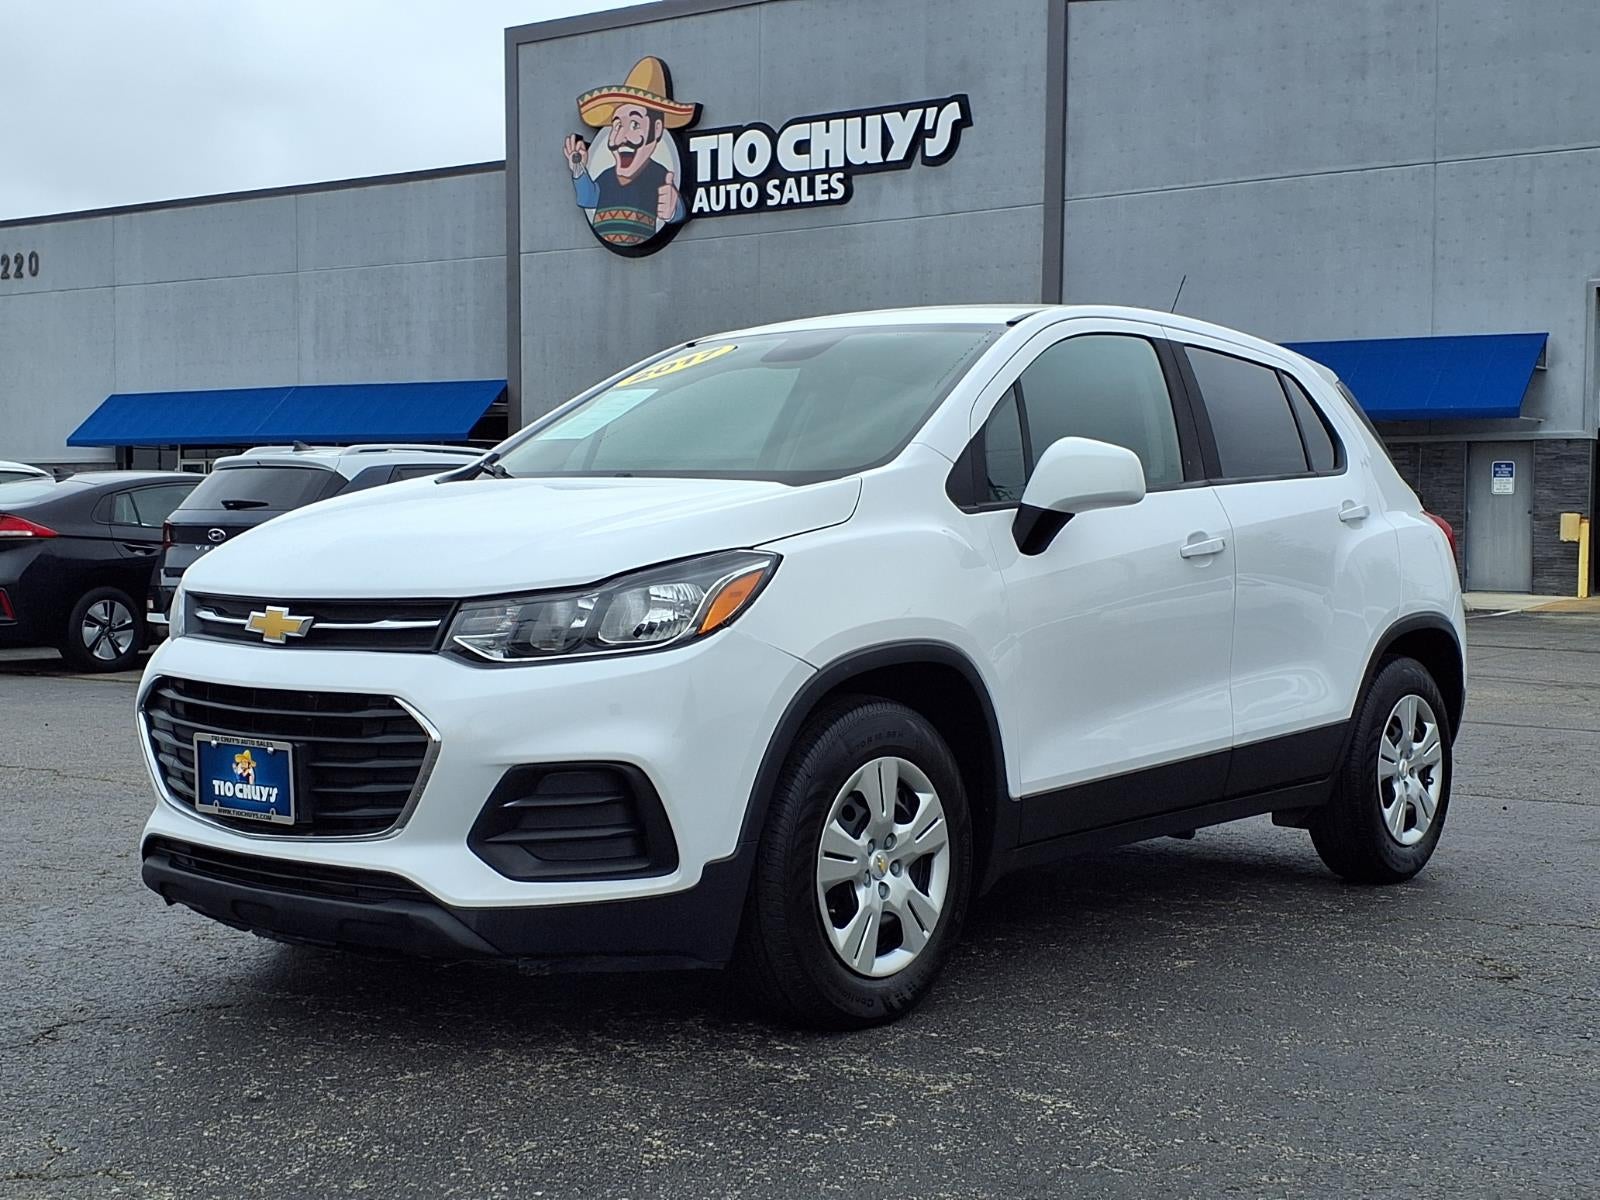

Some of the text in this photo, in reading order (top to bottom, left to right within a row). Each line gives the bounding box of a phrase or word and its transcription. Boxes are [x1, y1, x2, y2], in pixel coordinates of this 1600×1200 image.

[688, 101, 962, 183] TIO CHUY'S
[691, 172, 846, 214] AUTO SALES
[0, 250, 40, 280] 220
[627, 346, 723, 383] 2017
[212, 779, 278, 803] TIO CHUY'S
